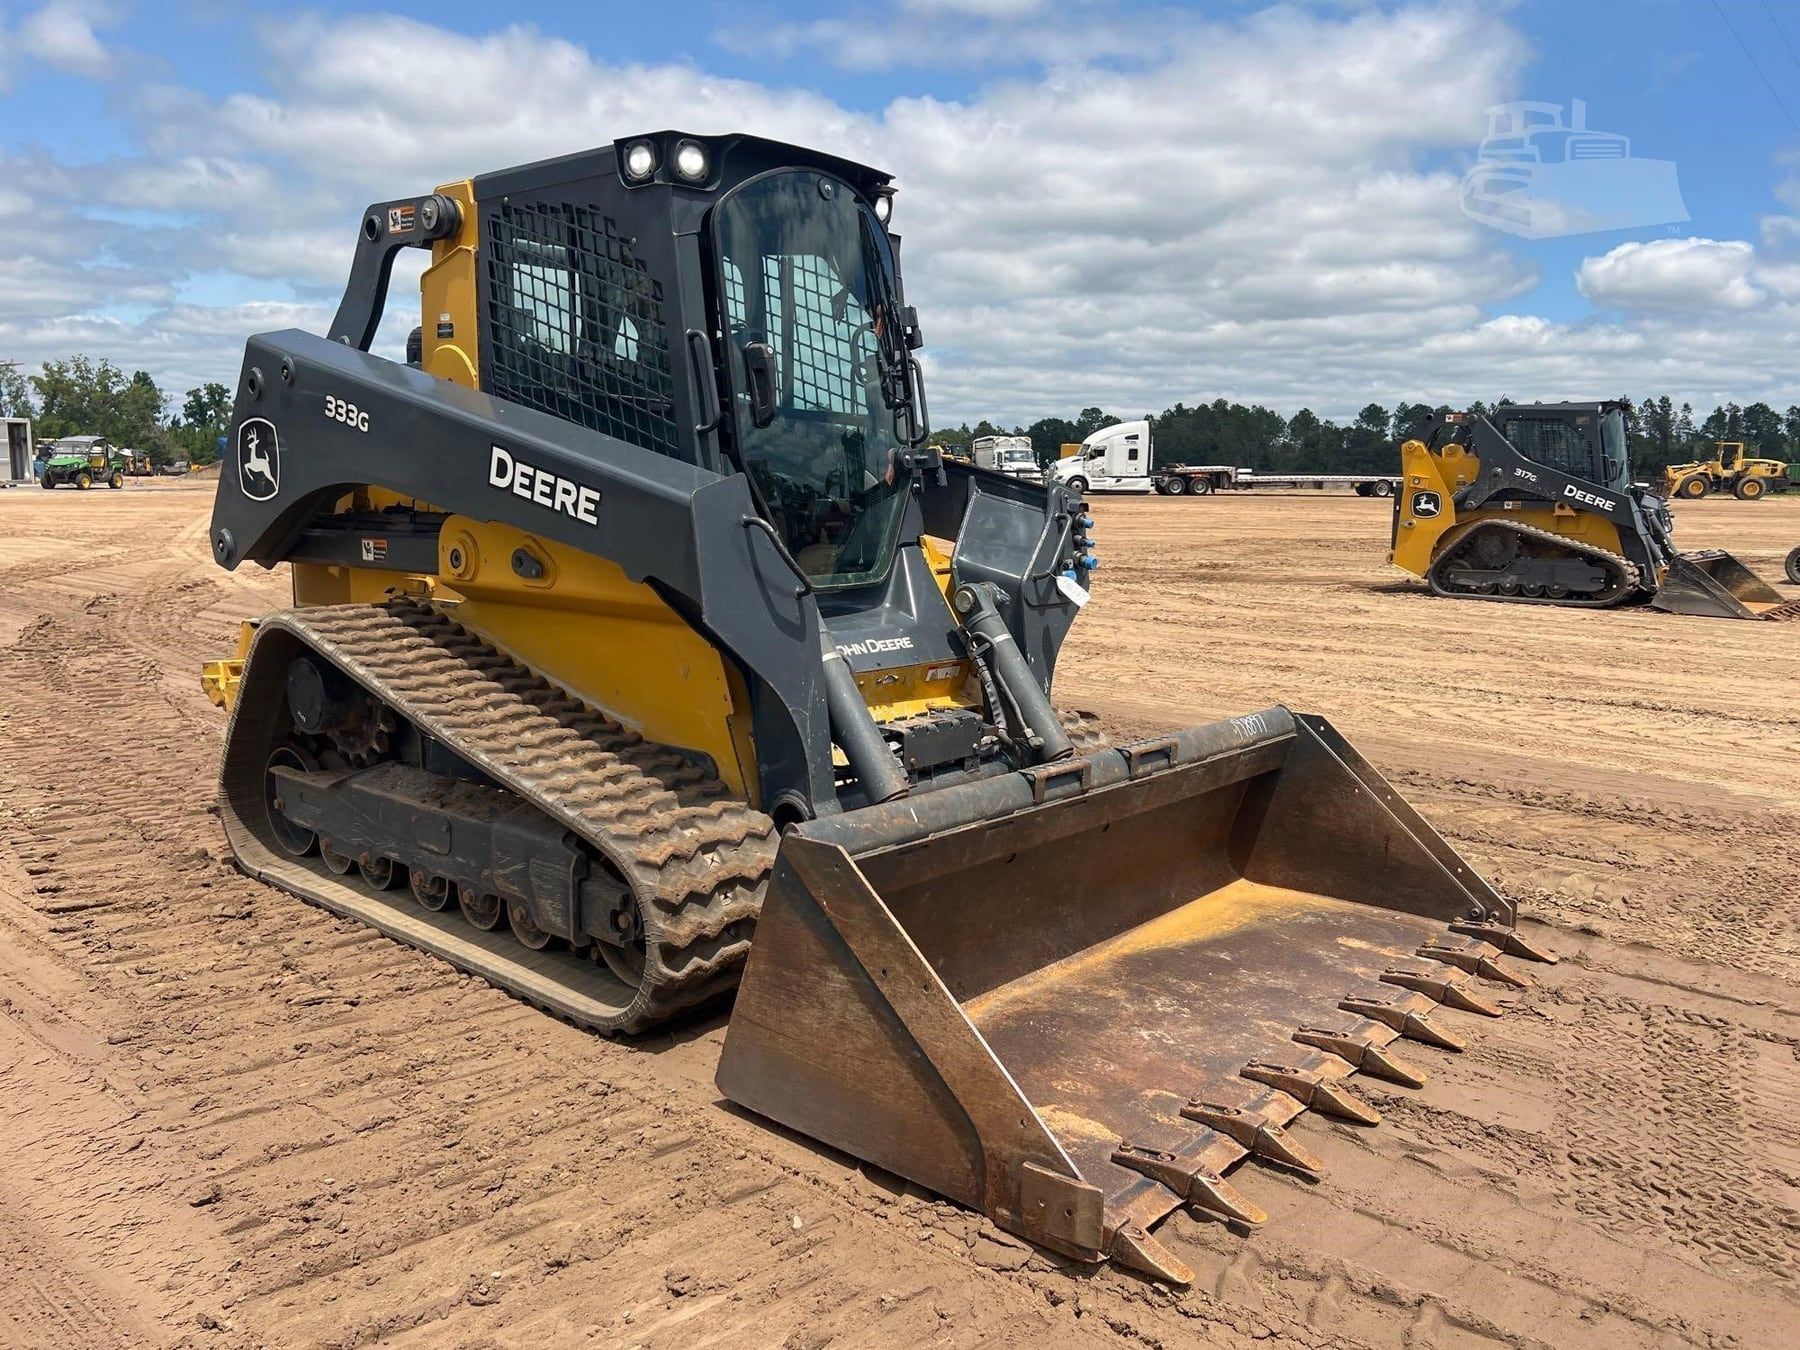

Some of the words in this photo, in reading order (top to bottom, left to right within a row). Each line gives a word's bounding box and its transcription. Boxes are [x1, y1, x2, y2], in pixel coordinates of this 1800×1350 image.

[324, 395, 369, 433] 333G
[489, 446, 601, 526] DEERE
[1513, 468, 1538, 482] 317G
[1563, 484, 1617, 512] DEERE
[835, 643, 869, 656] OHN
[865, 636, 914, 653] DEERE
